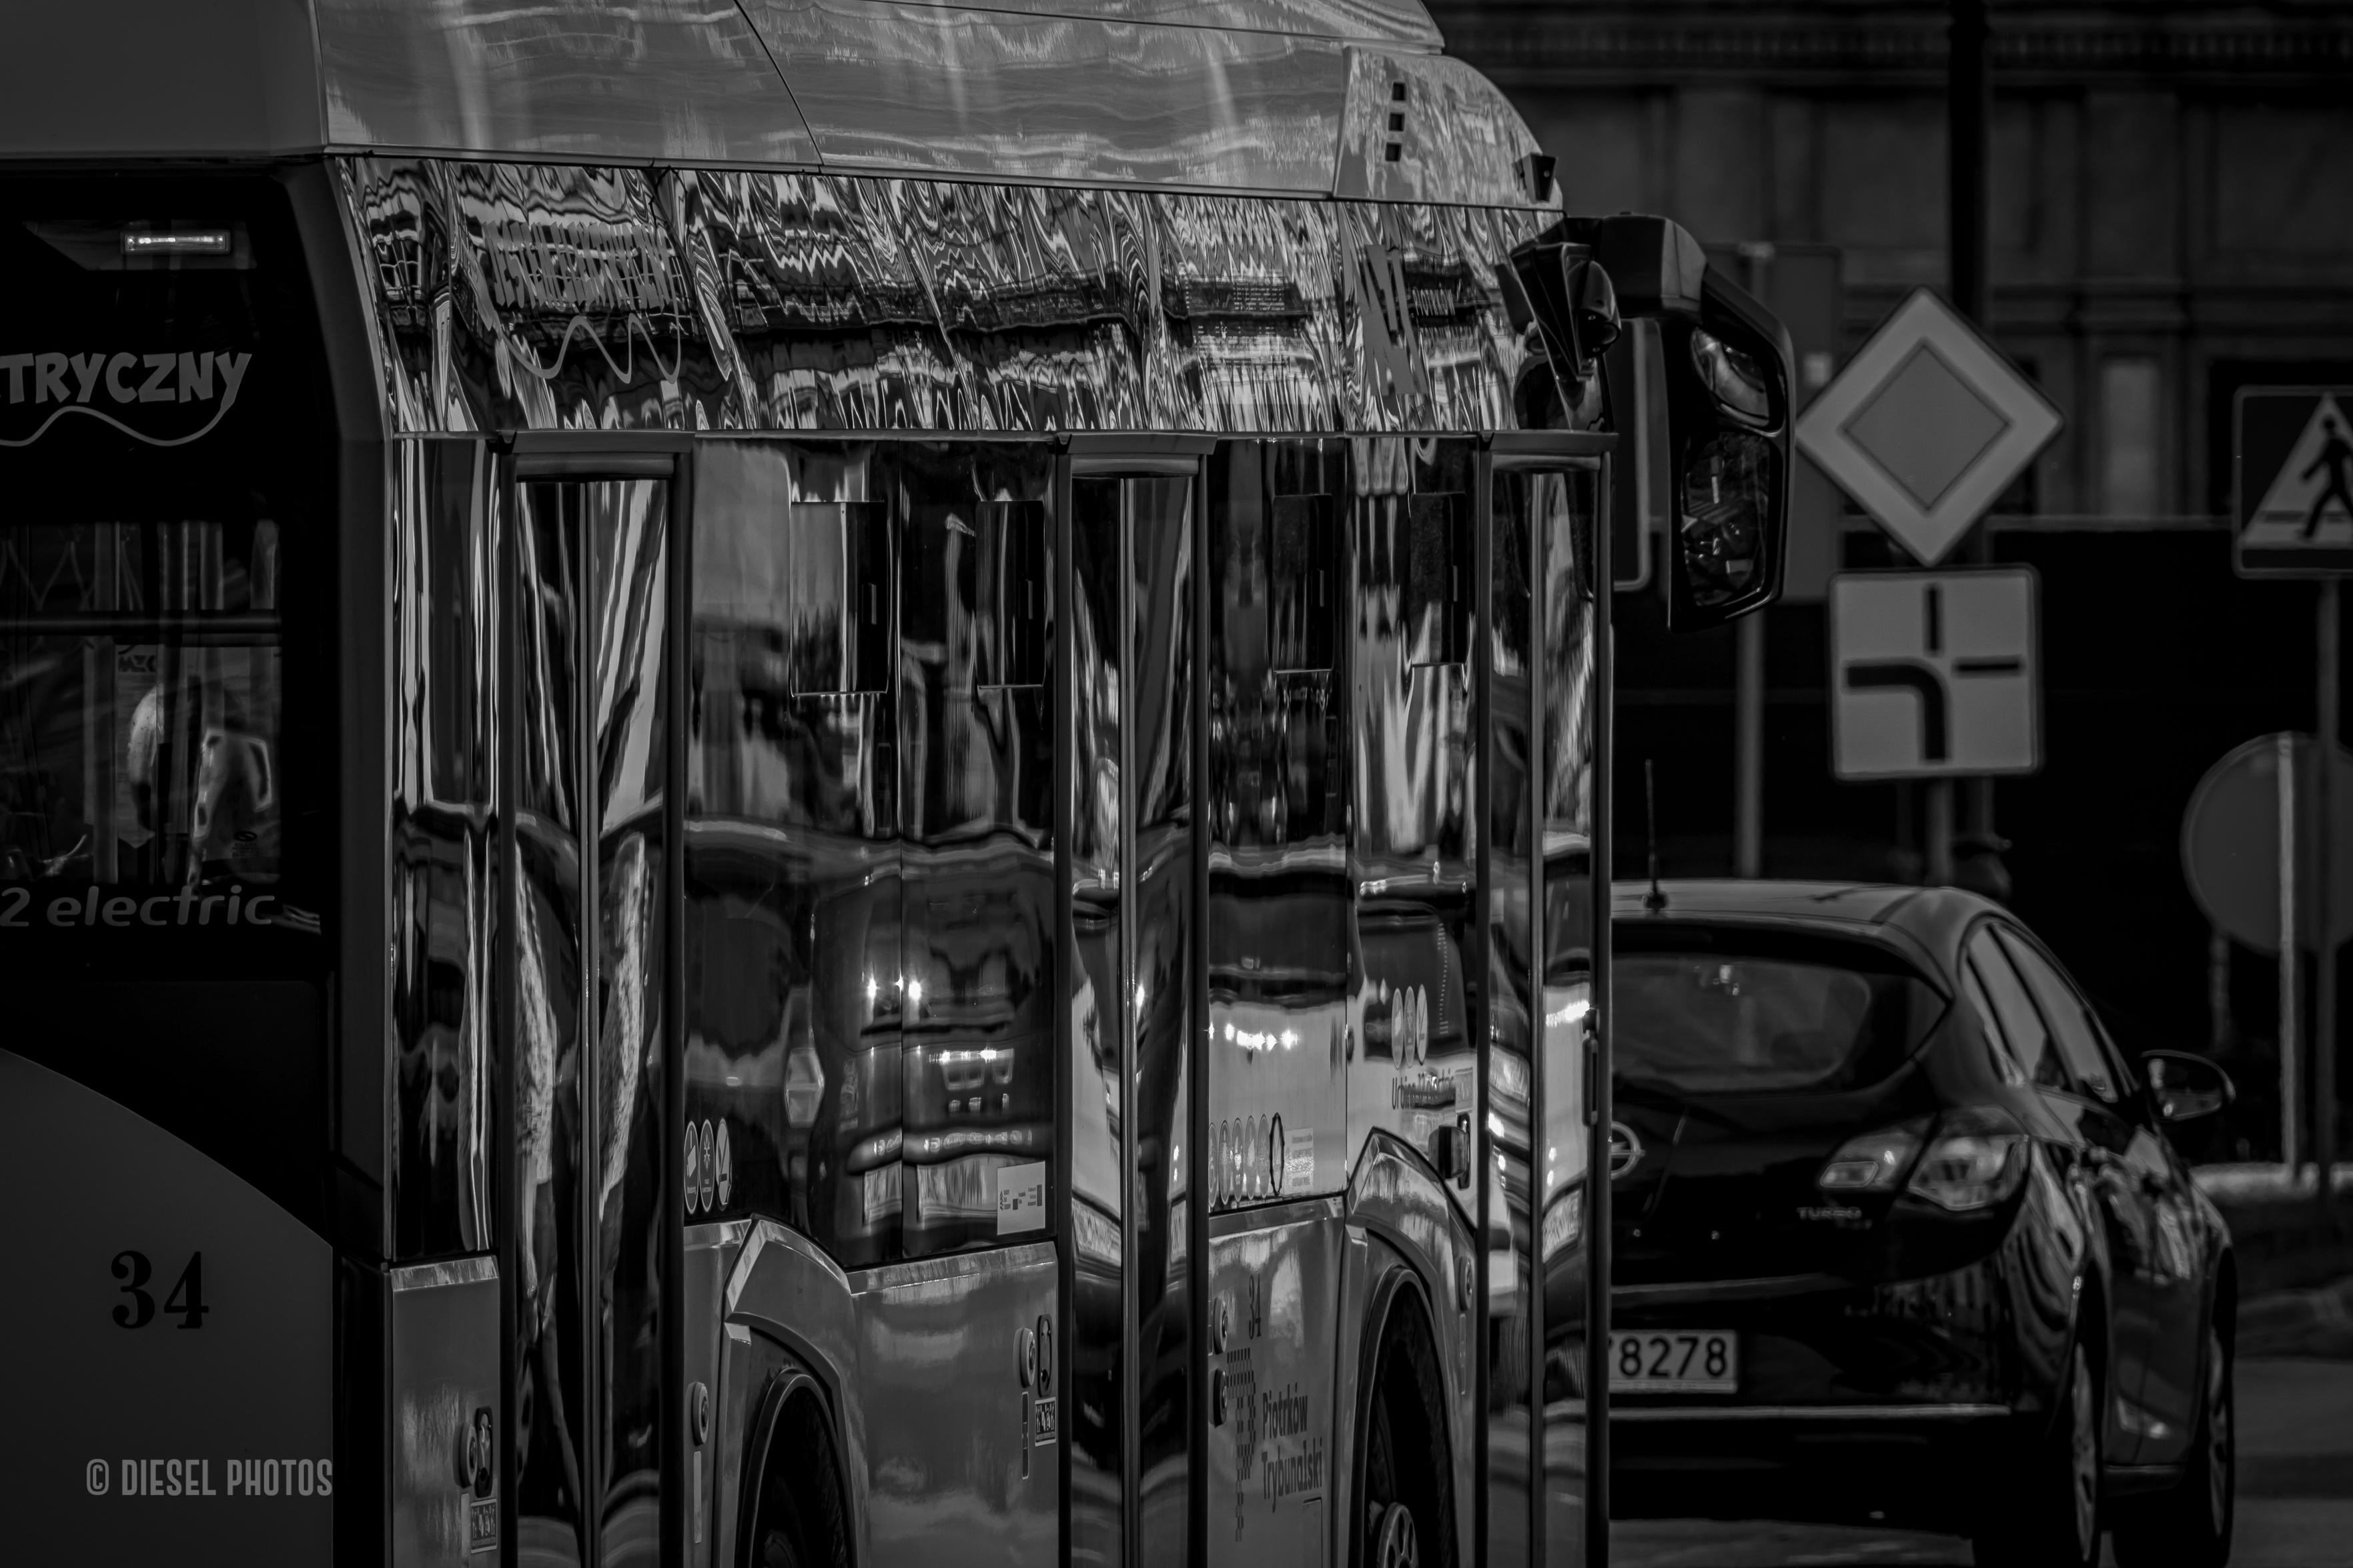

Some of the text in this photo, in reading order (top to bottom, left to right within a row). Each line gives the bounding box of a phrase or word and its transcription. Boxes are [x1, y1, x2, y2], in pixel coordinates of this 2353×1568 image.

[47, 885, 276, 926] electric
[111, 1251, 209, 1329] 34
[1249, 1273, 1261, 1339] 34
[1608, 1337, 1726, 1377] 8278
[1262, 1383, 1308, 1440] Piotrków
[1261, 1437, 1322, 1513] Trybunalski
